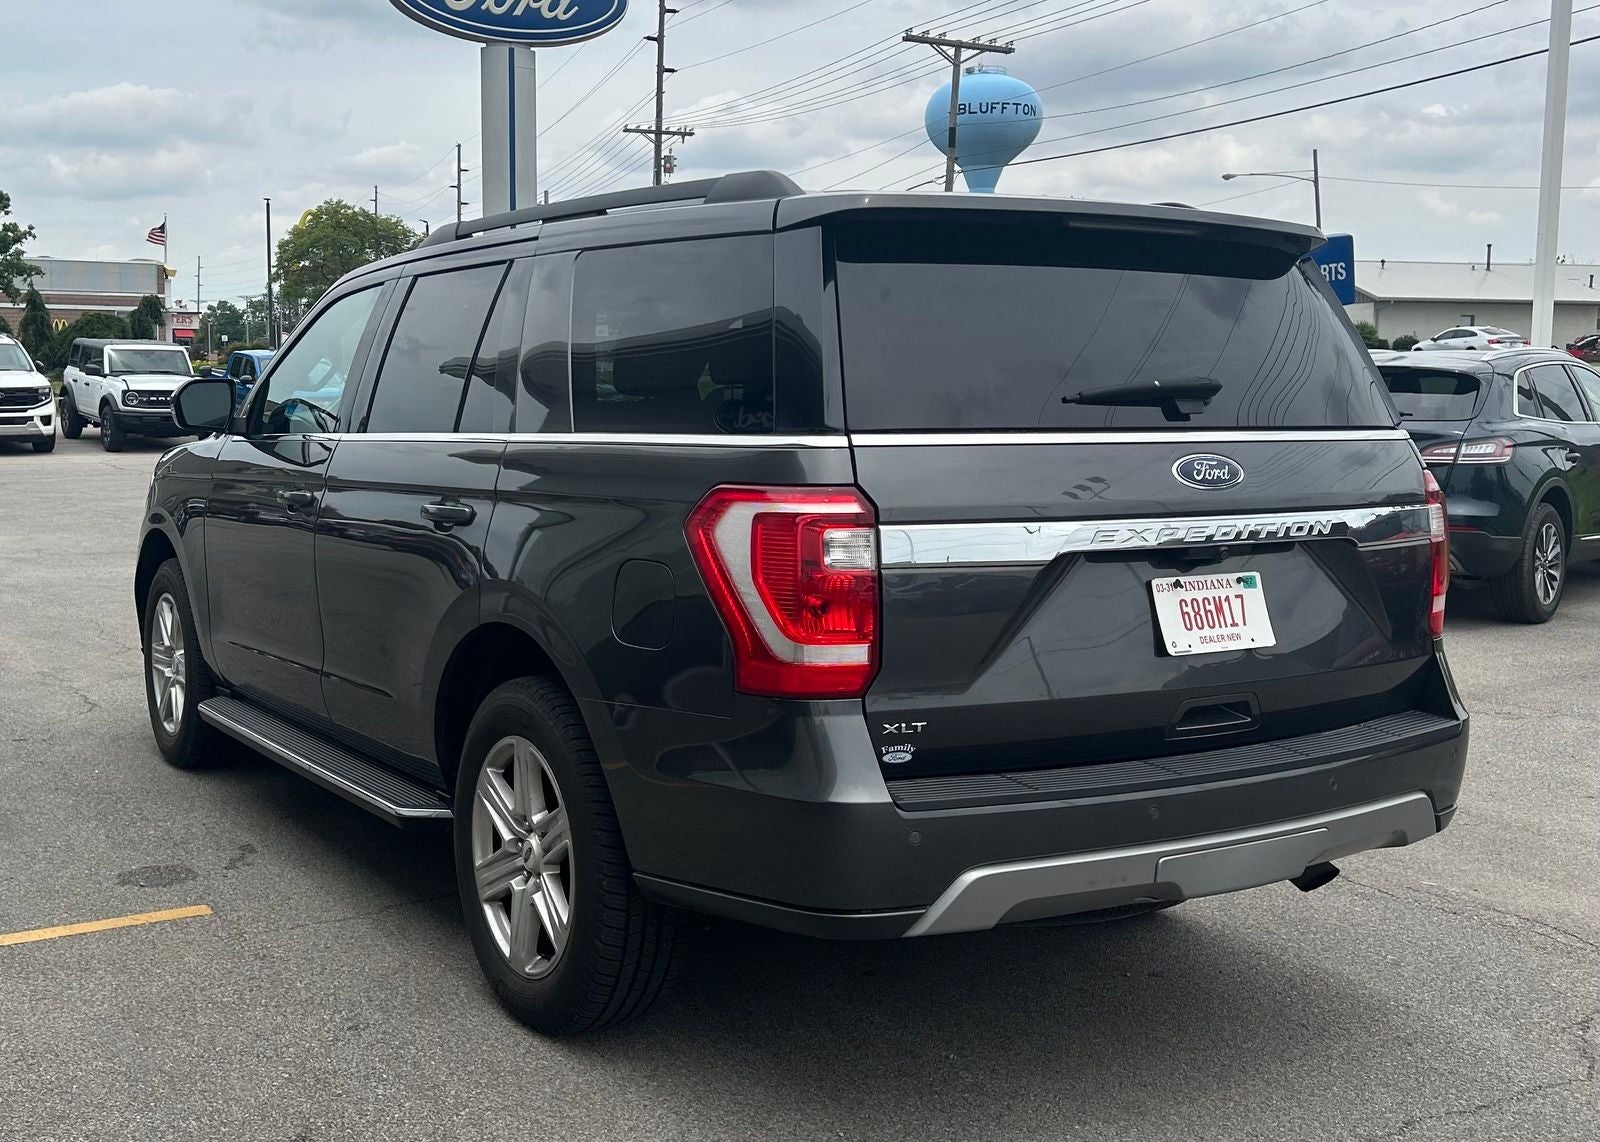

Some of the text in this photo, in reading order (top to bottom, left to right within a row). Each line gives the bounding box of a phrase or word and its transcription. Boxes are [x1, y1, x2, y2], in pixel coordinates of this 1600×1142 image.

[443, 0, 579, 21] ord
[957, 102, 1036, 116] BLUFFTON
[1320, 262, 1347, 282] RTS
[1193, 460, 1230, 480] Ford
[1090, 519, 1333, 546] EXPEDITION
[1156, 582, 1174, 593] 03-31
[1183, 578, 1233, 592] INDIANA
[1178, 593, 1248, 632] 686M17
[1199, 632, 1242, 645] DEALER NEW
[882, 722, 927, 734] XLT
[881, 744, 916, 754] Family
